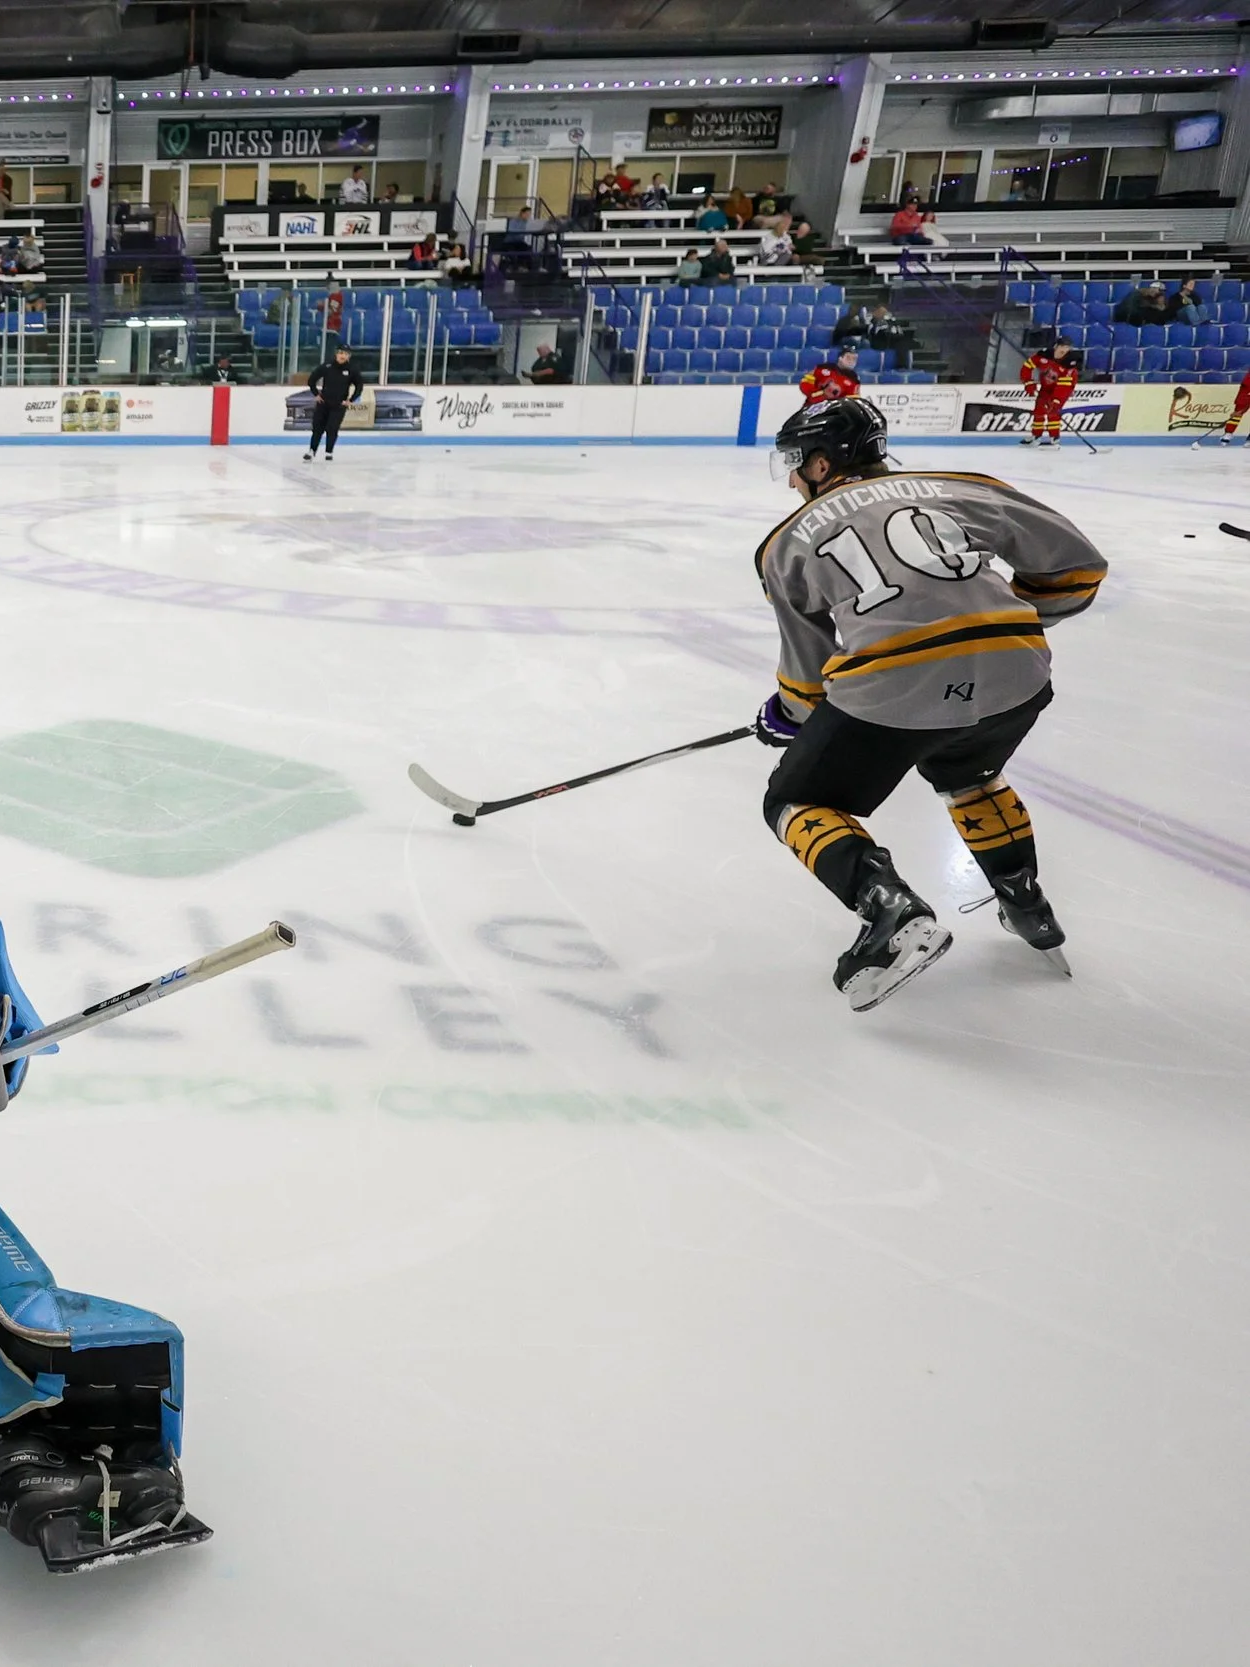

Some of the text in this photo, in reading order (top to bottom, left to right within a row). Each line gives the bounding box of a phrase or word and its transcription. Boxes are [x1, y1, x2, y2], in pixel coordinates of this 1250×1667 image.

[207, 128, 322, 157] PRESS BOX
[285, 218, 318, 236] NAHL
[25, 400, 58, 411] GRIZZLY
[1169, 386, 1230, 423] Ragazzi
[791, 479, 953, 546] VENTICINQUE
[815, 505, 982, 616] 10
[943, 681, 975, 702] K1
[18, 1475, 76, 1489] BAUER
